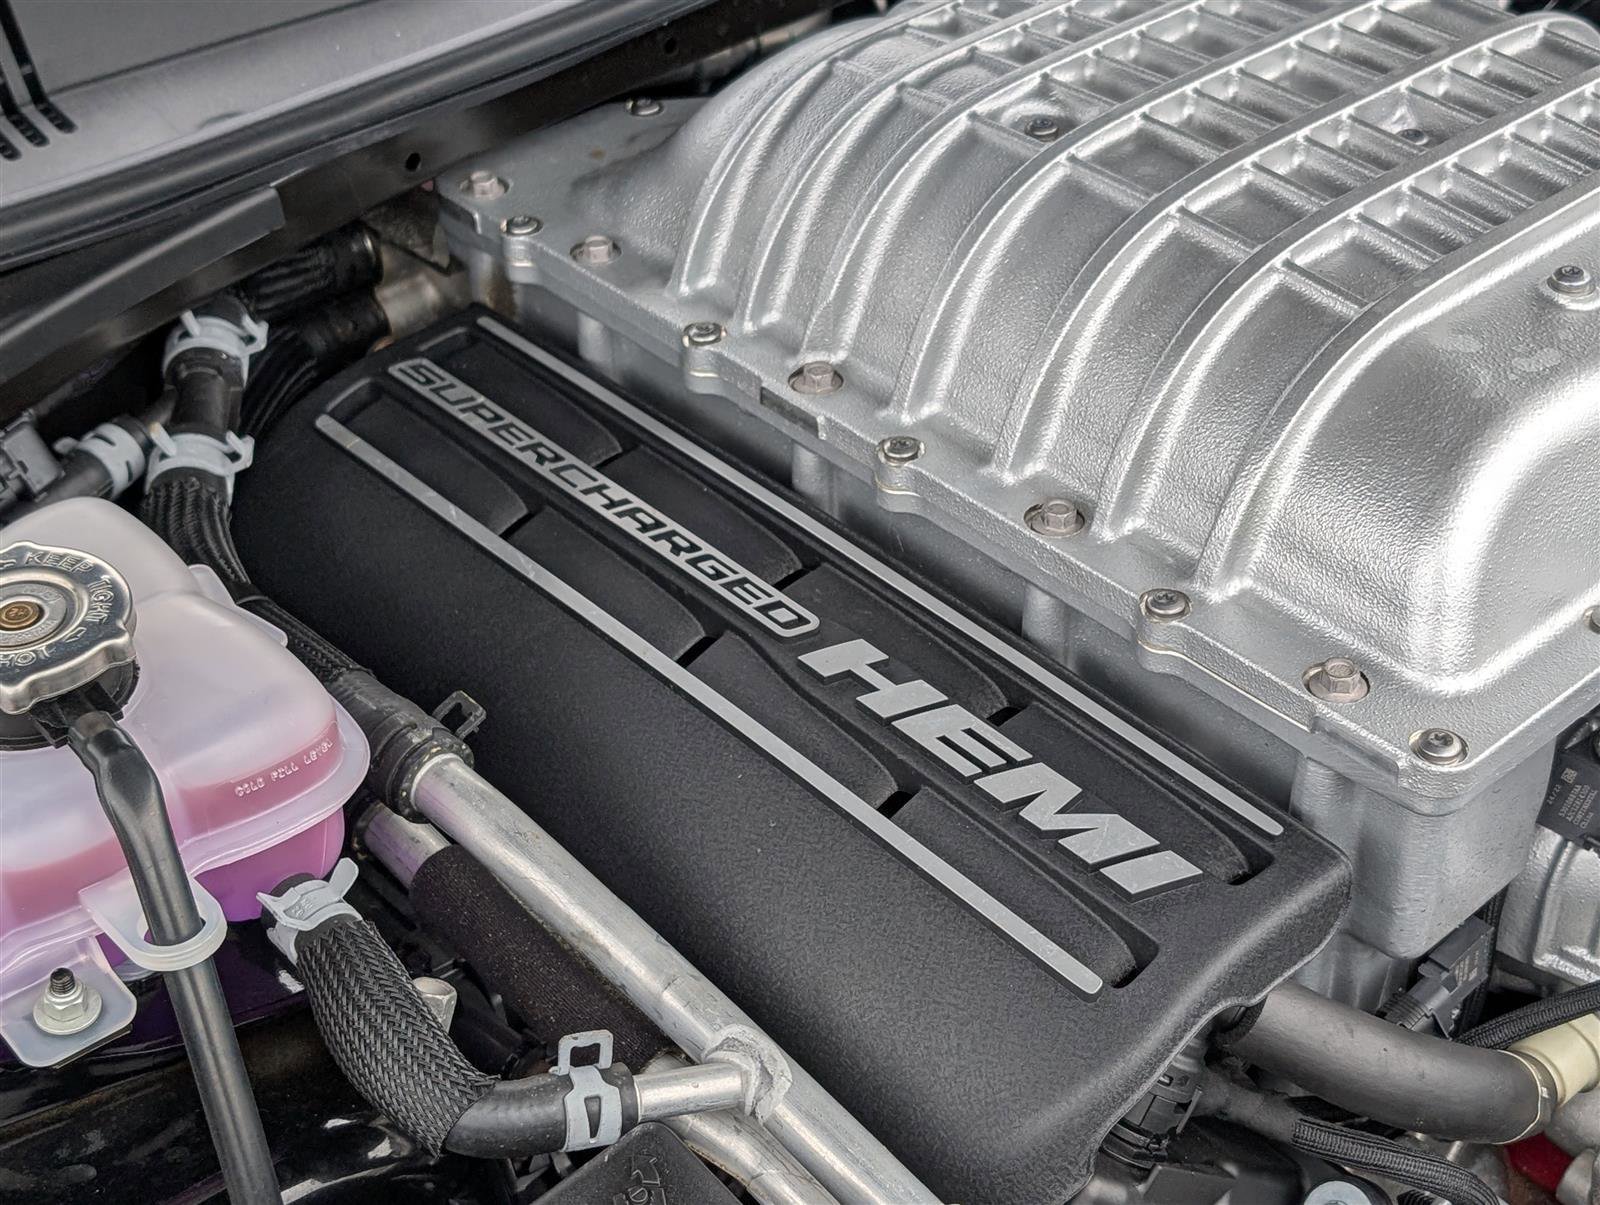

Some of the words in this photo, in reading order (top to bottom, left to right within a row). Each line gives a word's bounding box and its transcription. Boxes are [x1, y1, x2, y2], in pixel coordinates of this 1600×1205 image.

[397, 361, 803, 630] SUPERCHARGED
[25, 552, 93, 574] KEEP
[85, 575, 114, 623] TIGHT
[271, 762, 298, 781] FILL
[304, 738, 333, 764] LEVEL
[797, 638, 1203, 896] HEMI
